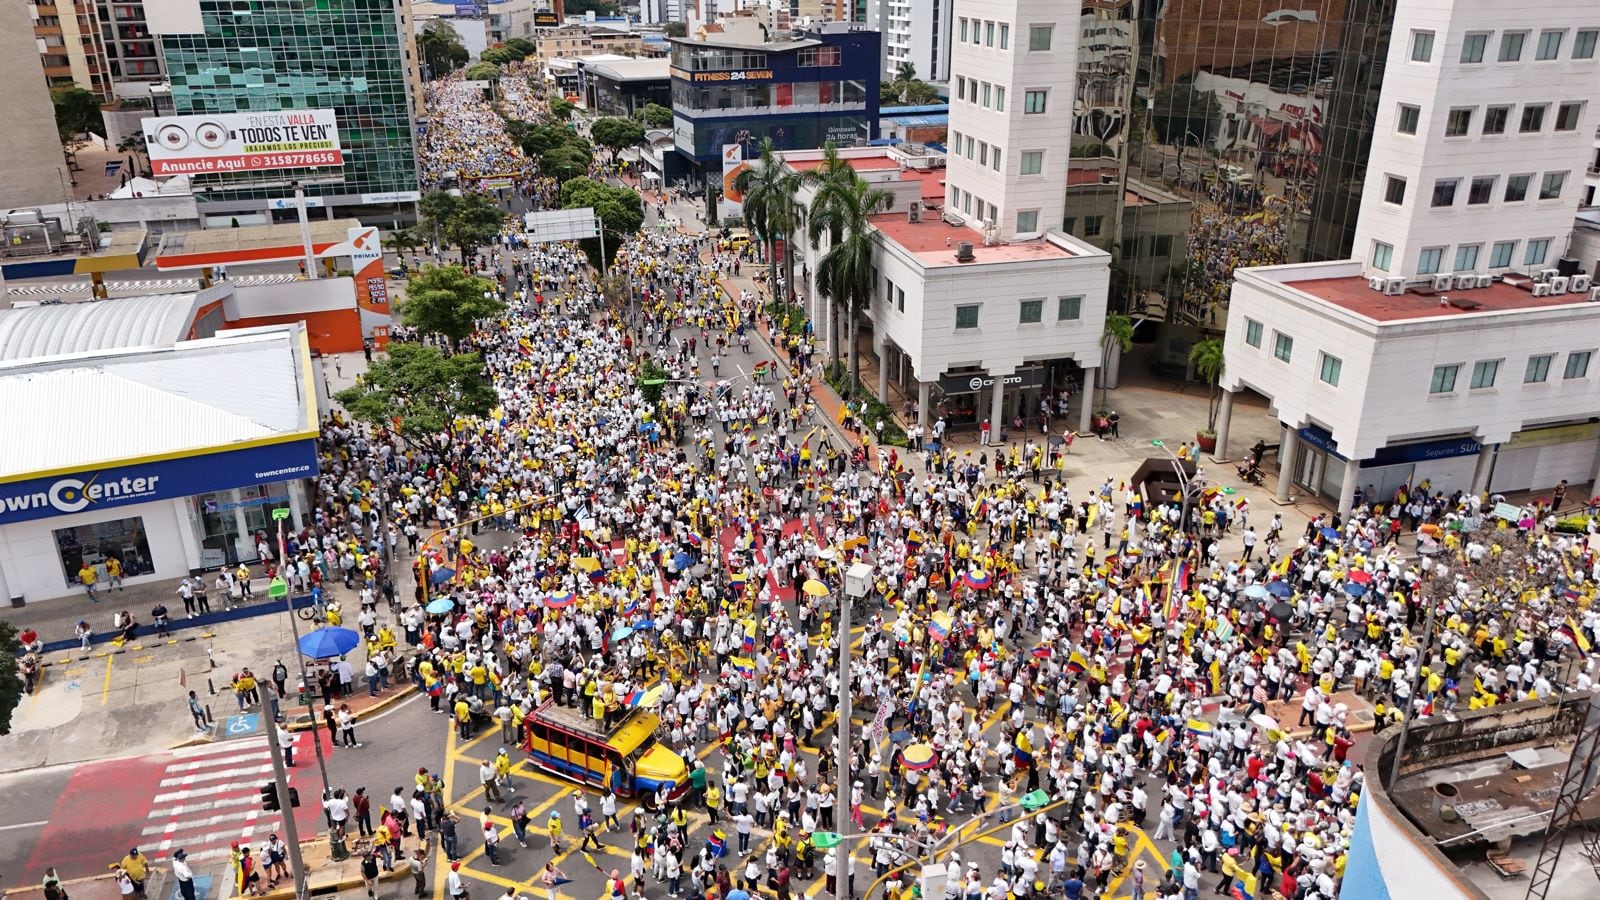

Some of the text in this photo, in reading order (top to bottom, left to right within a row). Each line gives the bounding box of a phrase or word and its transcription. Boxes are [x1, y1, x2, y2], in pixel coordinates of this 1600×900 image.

[694, 73, 730, 82] FITNESS
[730, 71, 745, 80] 24
[745, 70, 774, 79] SEVEN
[287, 114, 315, 125] VALLA
[239, 126, 282, 144] TODOS
[282, 125, 300, 141] TE
[161, 153, 335, 172] Anuncie Aquí 3158778656
[983, 377, 1022, 386] CFOTO
[255, 465, 309, 478] towncenter.co
